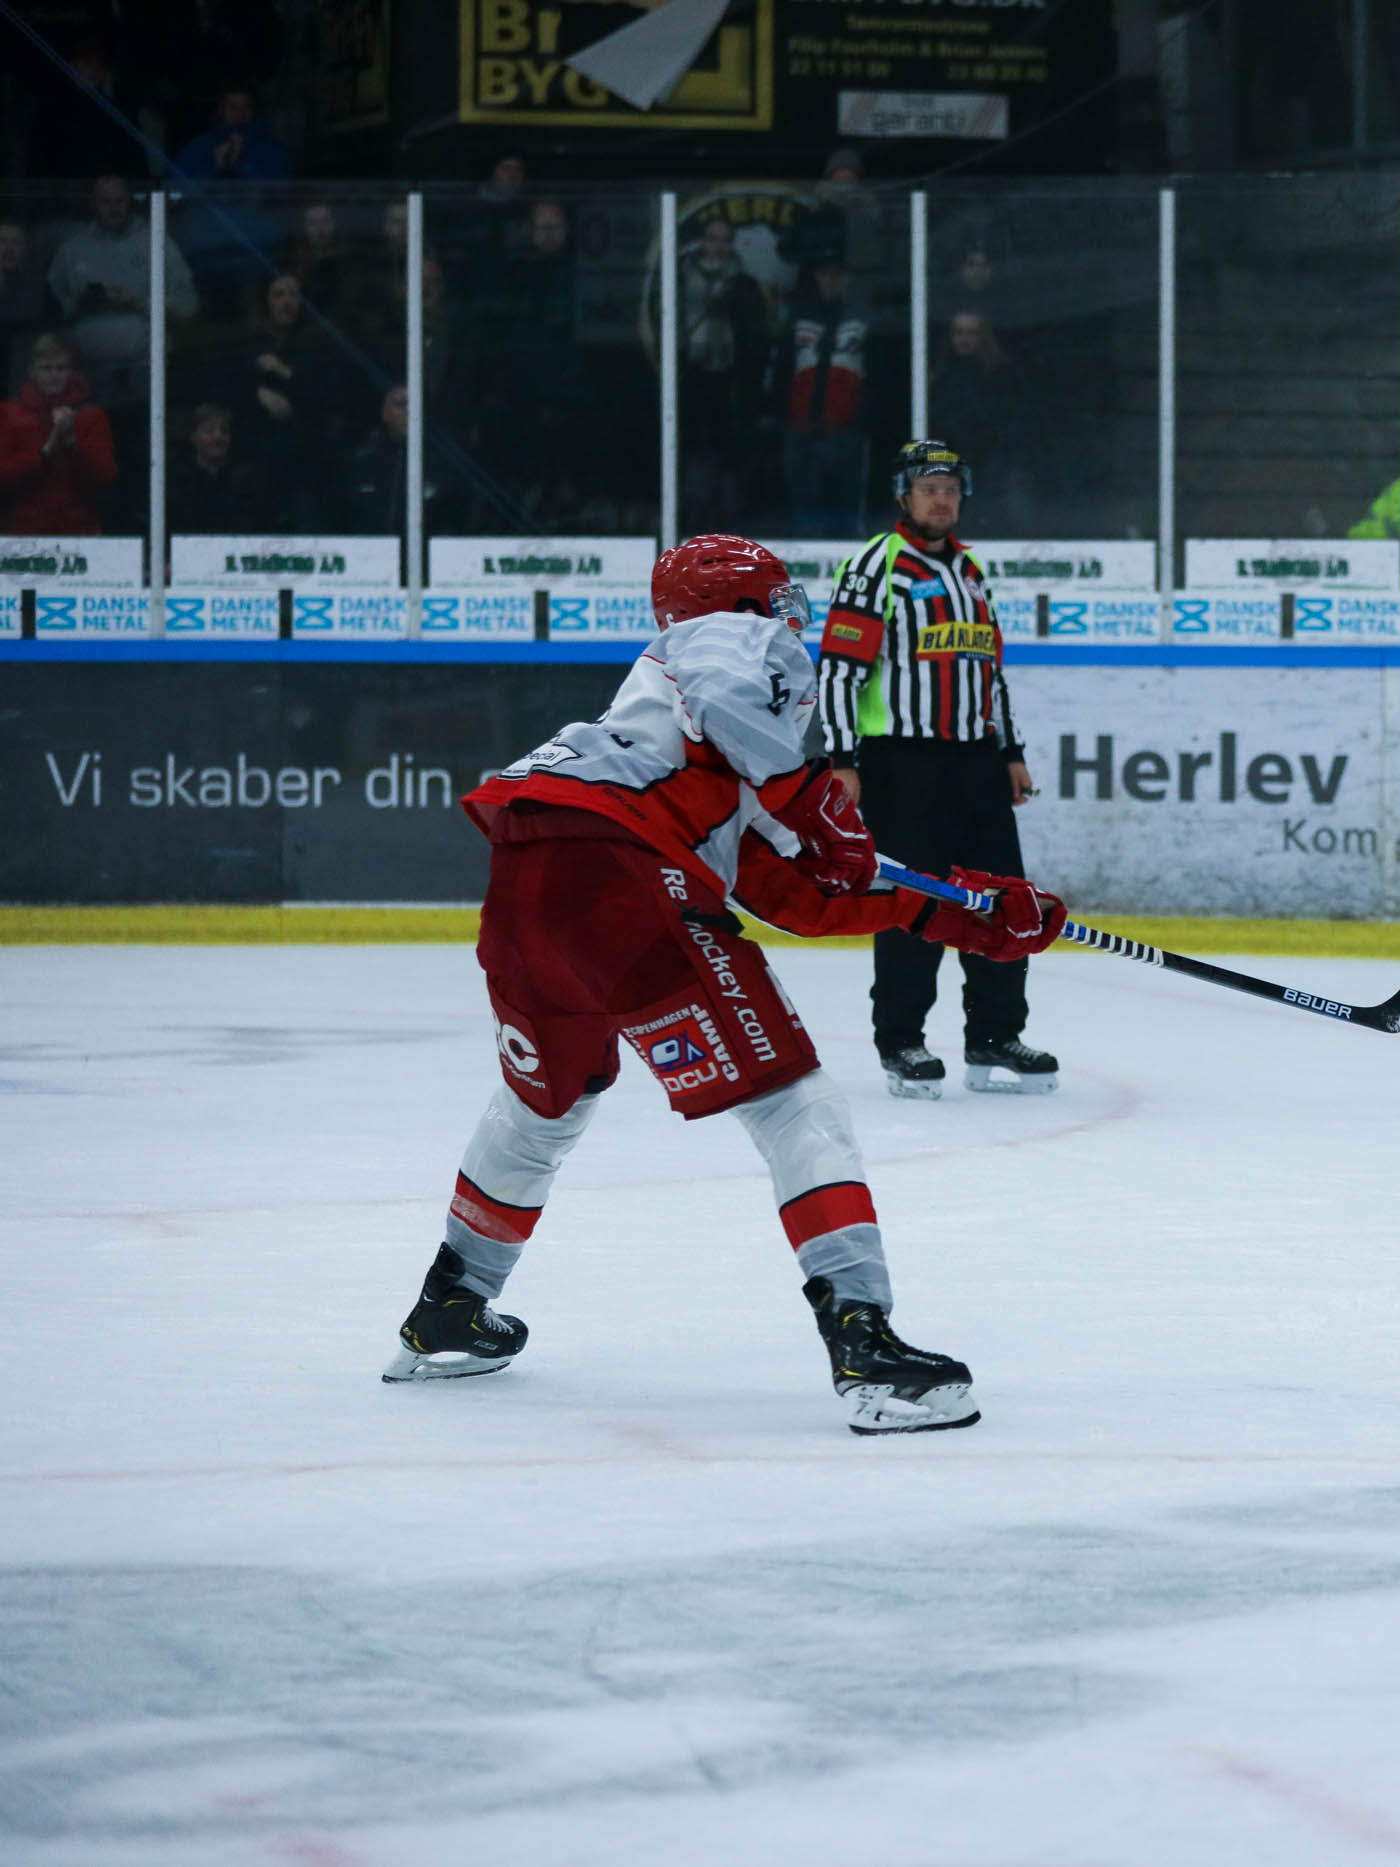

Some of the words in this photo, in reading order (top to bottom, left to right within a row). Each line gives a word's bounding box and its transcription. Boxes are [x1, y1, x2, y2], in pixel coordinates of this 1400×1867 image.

[845, 573, 868, 593] 30
[83, 597, 150, 612] DANSK
[211, 597, 278, 613] DANSK
[340, 597, 407, 613] DANSK
[465, 597, 532, 613] DANSK
[596, 597, 653, 613] DANS
[1337, 599, 1400, 614] DANSK
[82, 615, 147, 631] METAL
[211, 616, 276, 632] METAL
[340, 616, 405, 632] METAL
[465, 616, 529, 632] METAL
[1337, 618, 1398, 634] METAL
[1058, 731, 1349, 805] Herlev
[45, 752, 101, 806] Vi
[129, 753, 341, 808] skaber
[365, 753, 452, 808] din
[1282, 987, 1352, 1019] BAUER
[662, 1061, 719, 1092] DCU
